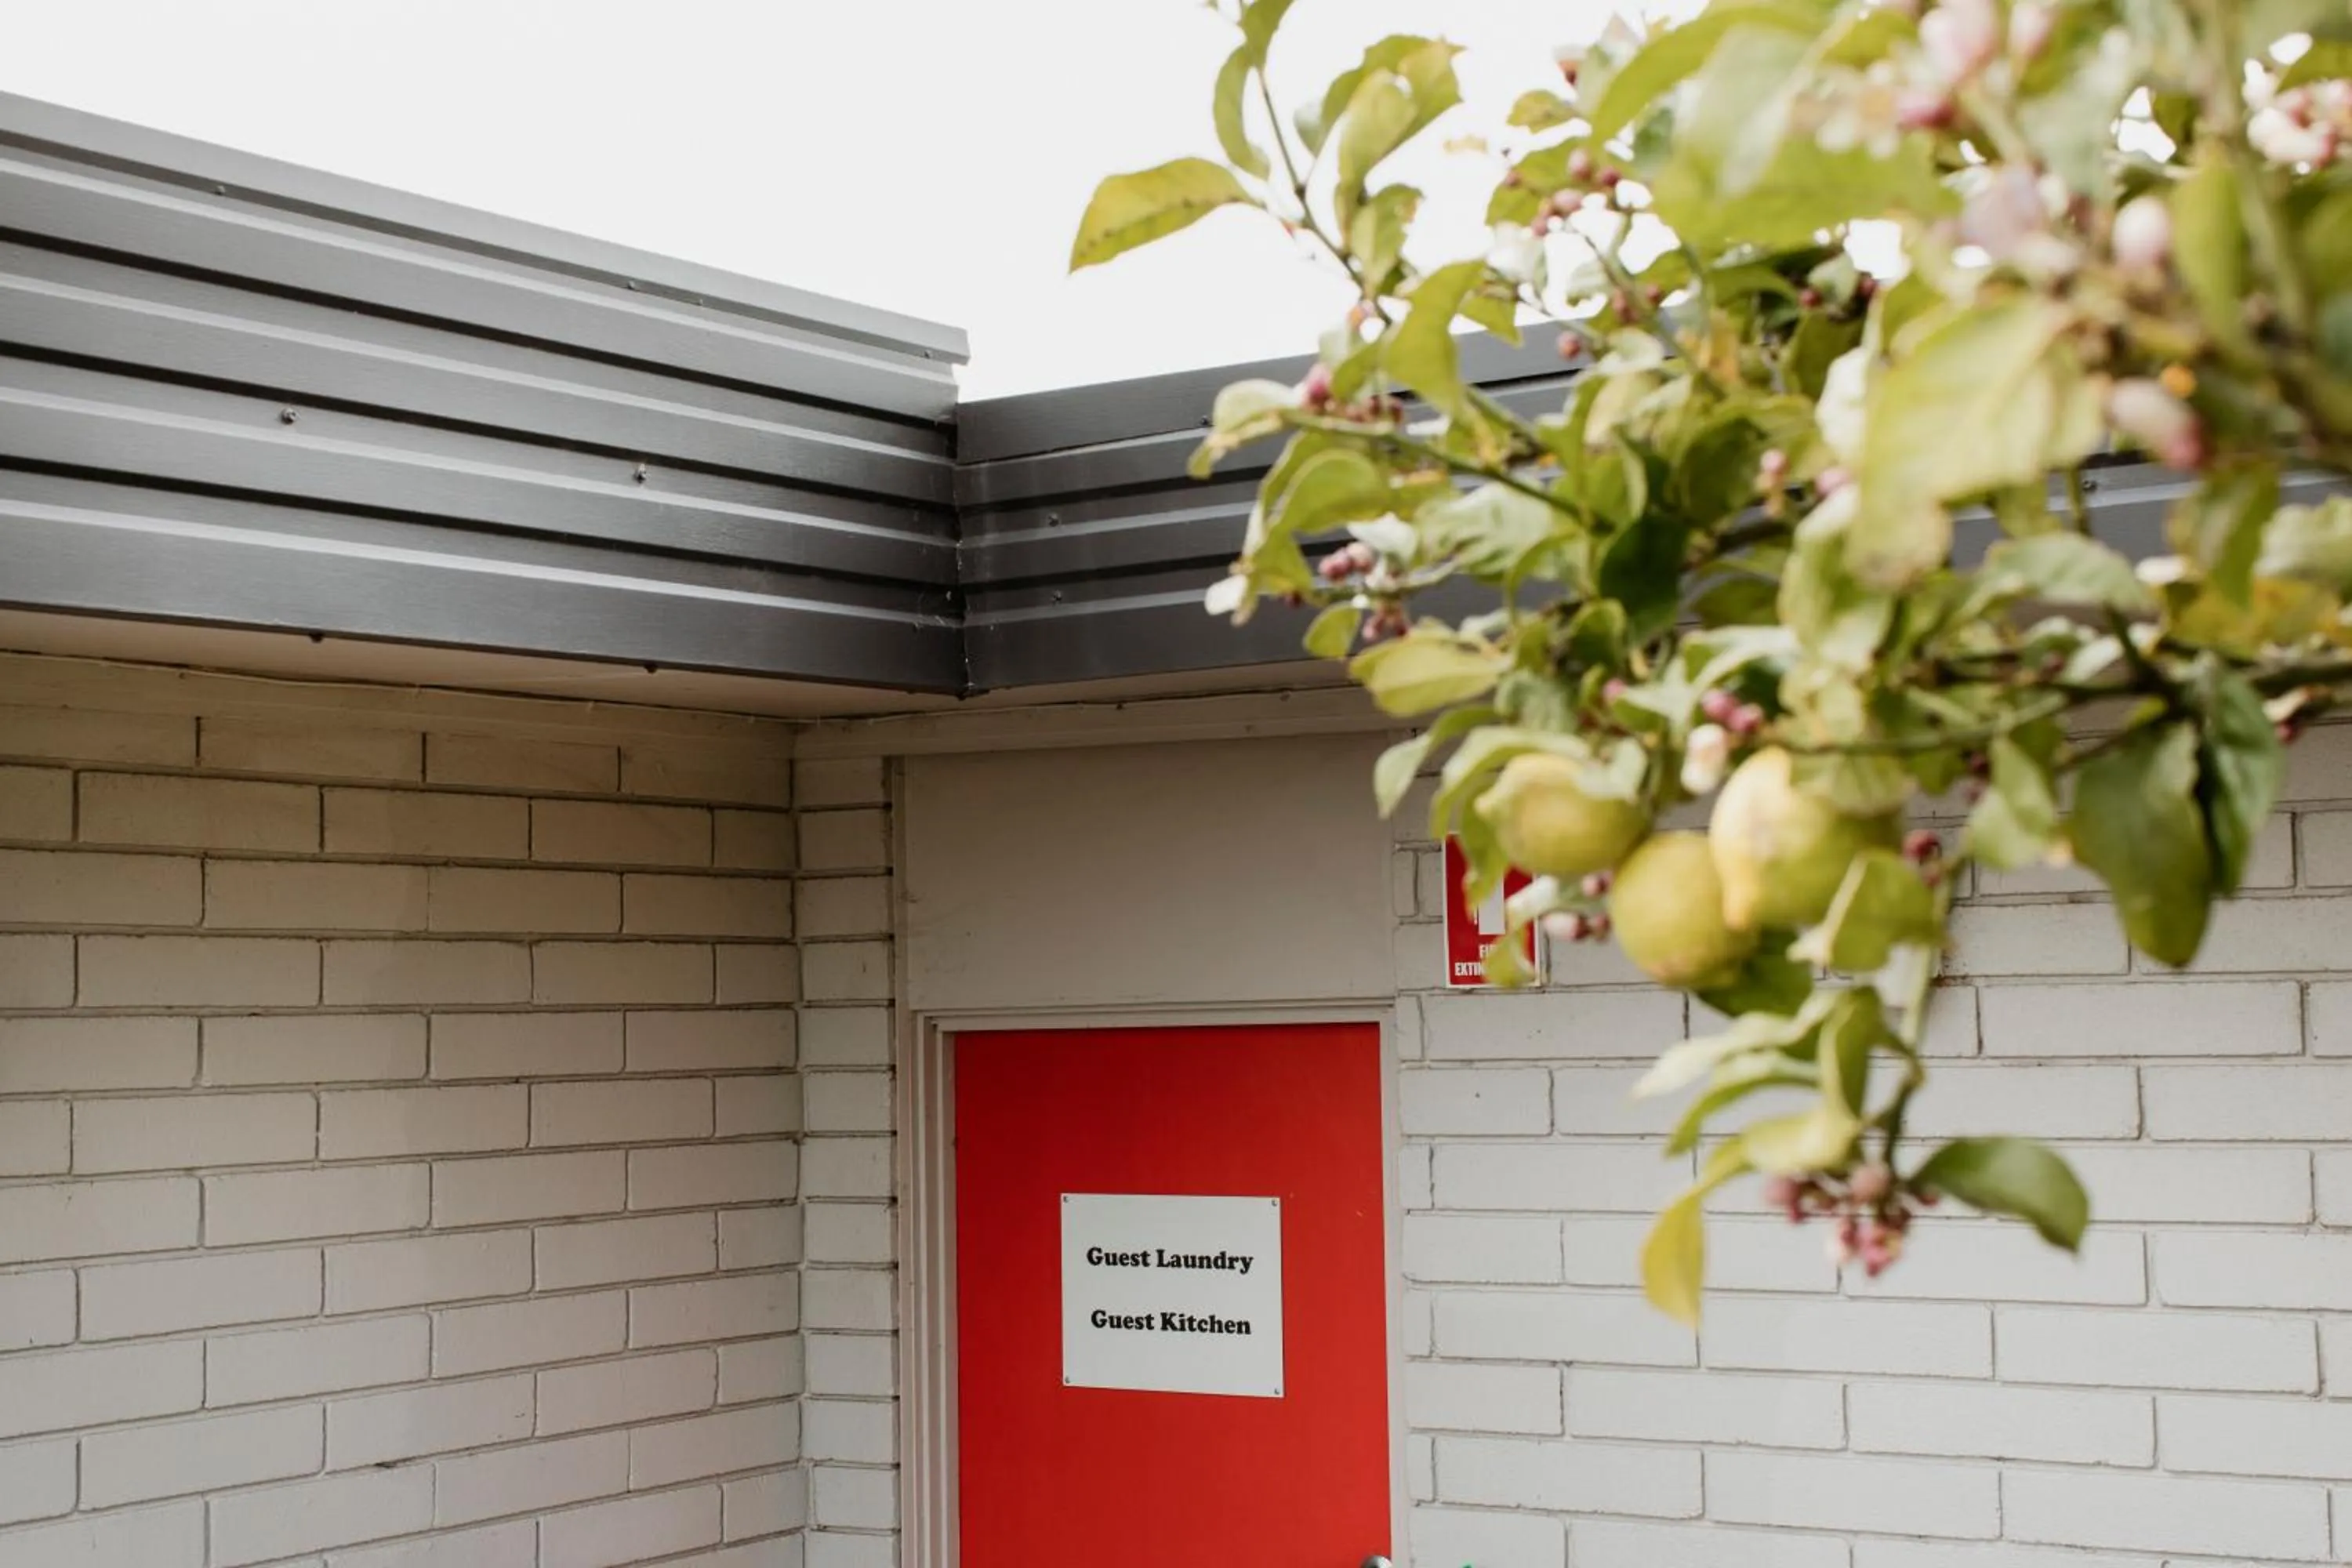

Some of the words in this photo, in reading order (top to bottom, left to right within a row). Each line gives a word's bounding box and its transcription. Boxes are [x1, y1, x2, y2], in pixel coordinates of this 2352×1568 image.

[1086, 1247, 1151, 1268] Guest
[1156, 1248, 1254, 1275] Laundry
[1091, 1309, 1155, 1330] Guest
[1160, 1312, 1251, 1335] Kitchen
